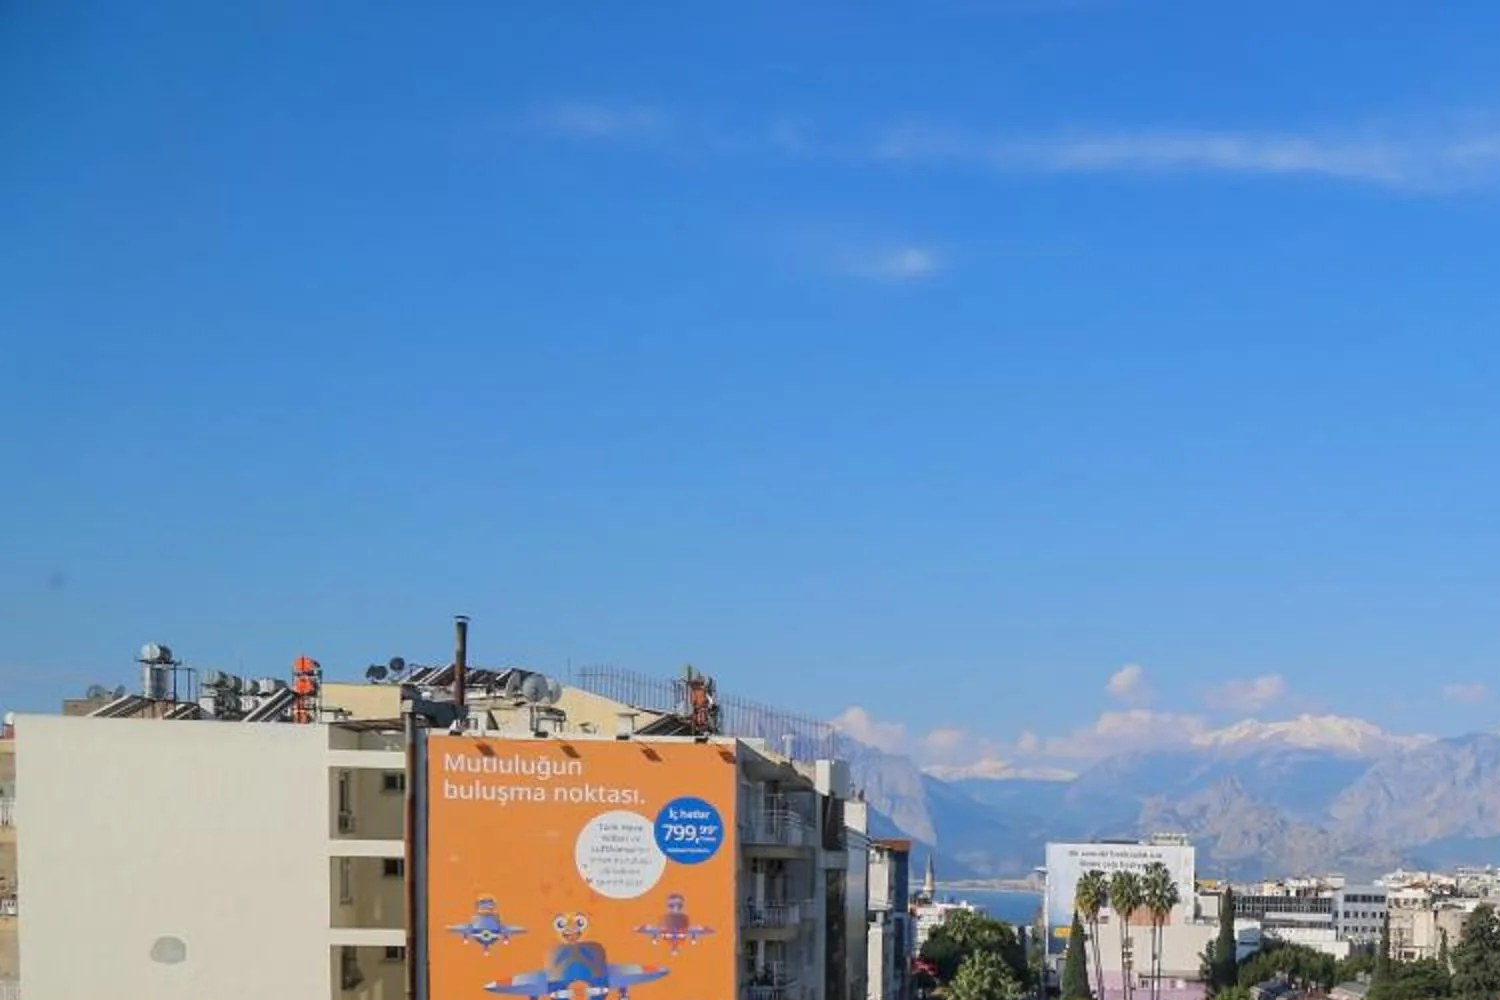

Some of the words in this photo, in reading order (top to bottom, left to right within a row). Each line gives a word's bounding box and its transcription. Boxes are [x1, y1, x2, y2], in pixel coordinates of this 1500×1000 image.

[444, 753, 582, 780] Mutluluğun
[444, 780, 545, 806] buluşma
[554, 784, 646, 805] noktası.
